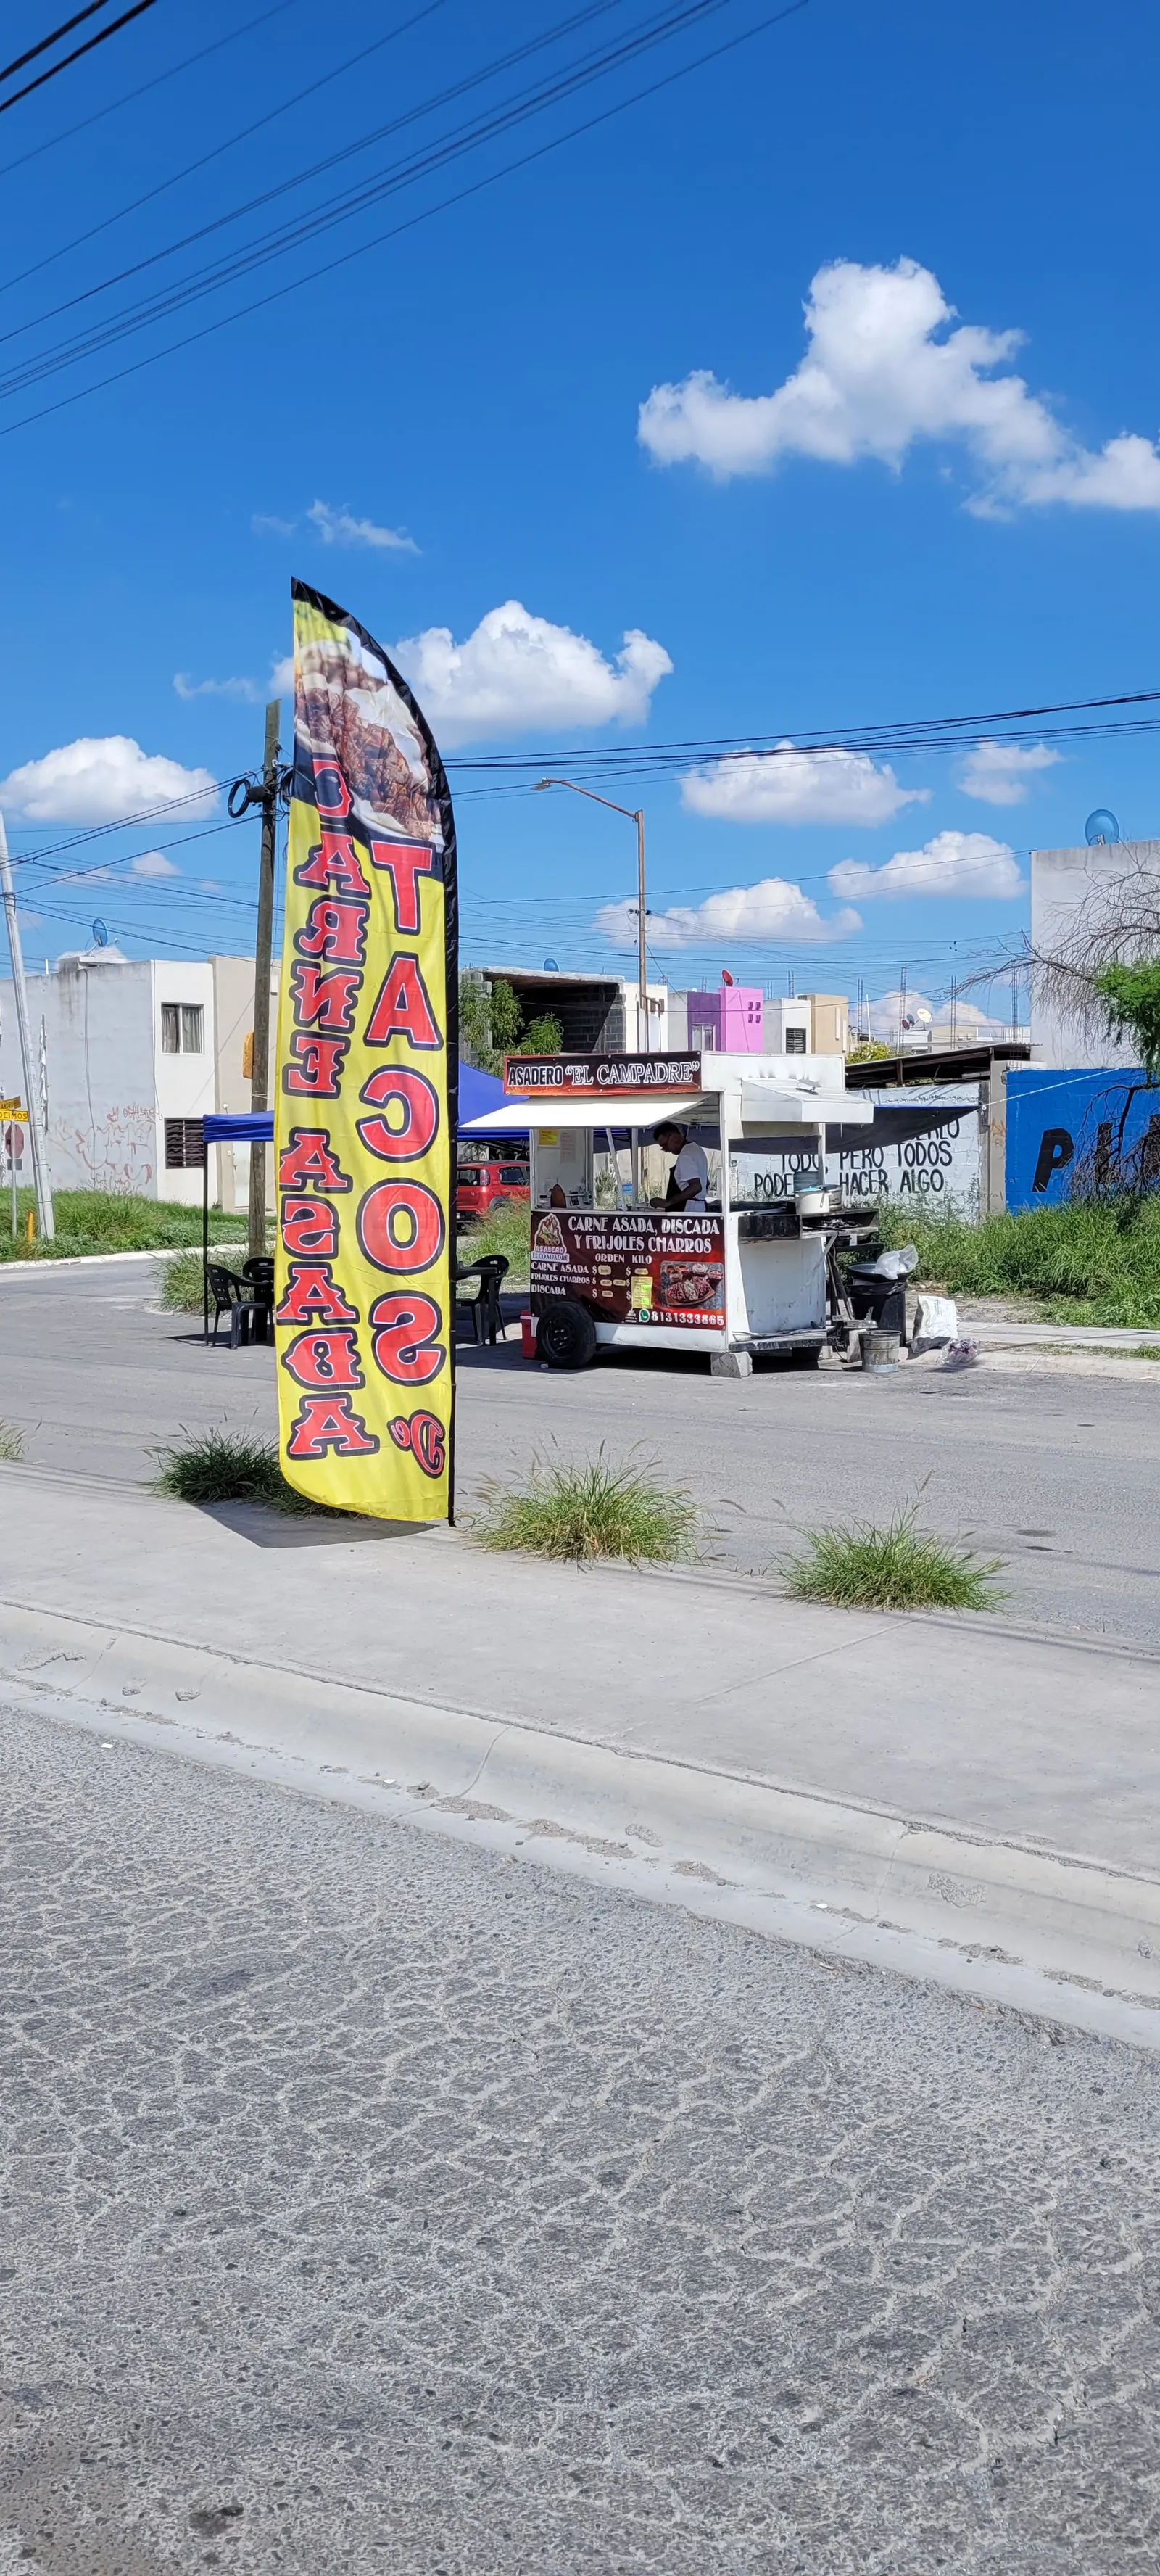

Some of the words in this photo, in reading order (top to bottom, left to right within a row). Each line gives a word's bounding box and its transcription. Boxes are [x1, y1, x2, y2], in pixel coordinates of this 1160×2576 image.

[508, 1065, 563, 1086] ASADERO
[840, 1146, 884, 1170] PERO
[897, 1141, 953, 1167] TODOS
[839, 1168, 889, 1196] HACER
[900, 1168, 945, 1194] ALGO
[568, 1215, 608, 1232] CARNE
[613, 1217, 658, 1236] ASADA,
[661, 1218, 719, 1235] DISCADA
[536, 1245, 564, 1254] ASADERO
[574, 1234, 582, 1249] Y
[585, 1235, 645, 1251] FRIJOLES
[647, 1237, 712, 1253] CHARROS
[594, 1253, 624, 1263] ORDEN
[632, 1254, 652, 1265] KILO
[531, 1262, 558, 1272] CARNE
[560, 1264, 589, 1273] ASADA
[531, 1273, 558, 1282] FRIJOLES
[559, 1275, 590, 1284] CHARROS
[531, 1284, 566, 1295] DISCADA
[651, 1310, 724, 1326] 8131333865
